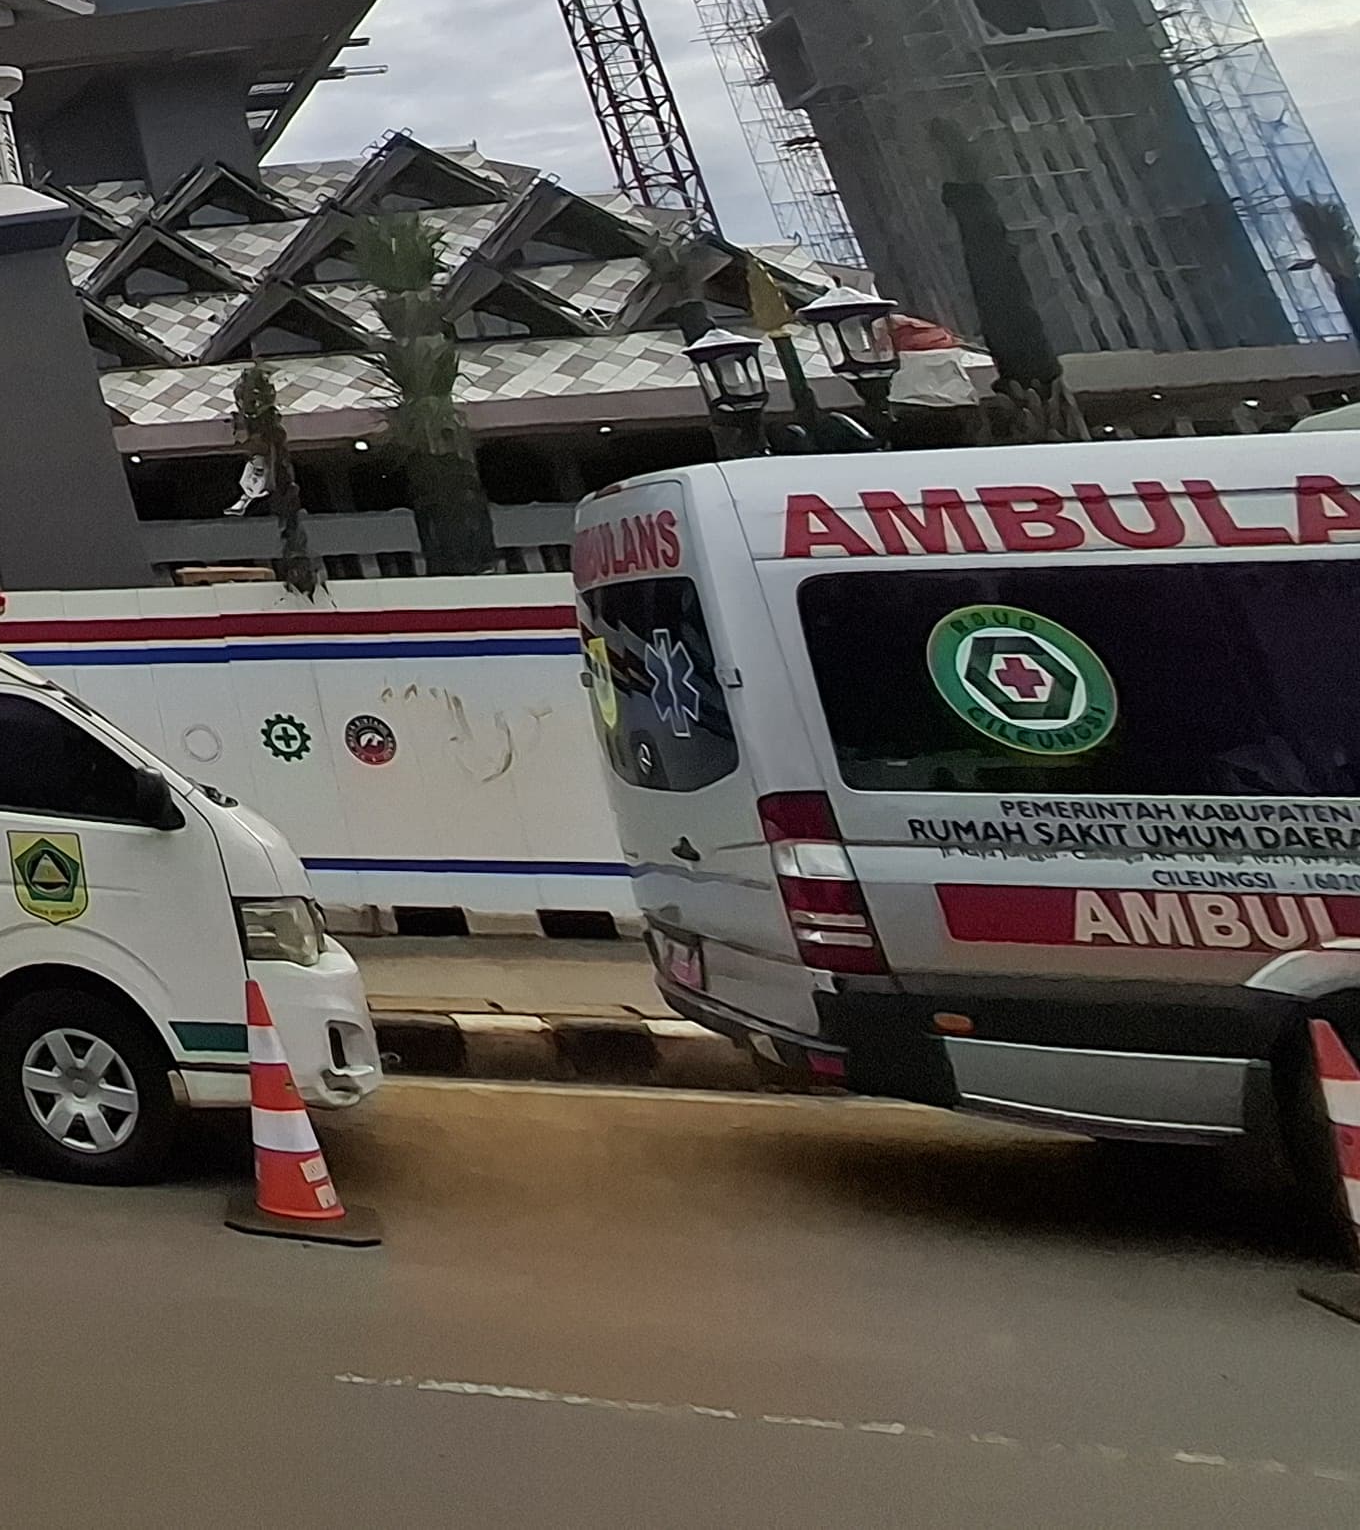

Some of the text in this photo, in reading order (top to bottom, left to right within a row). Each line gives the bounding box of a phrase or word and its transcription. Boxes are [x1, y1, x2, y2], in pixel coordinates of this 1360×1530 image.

[784, 475, 1360, 556] AMBULA
[1000, 800, 1354, 822] PEMERINTAH KABUPATEN
[908, 819, 1030, 845] RUMAH
[1034, 822, 1128, 847] SAKIT
[1137, 825, 1249, 849] UMUM
[1152, 870, 1277, 888] CILEUNGSI
